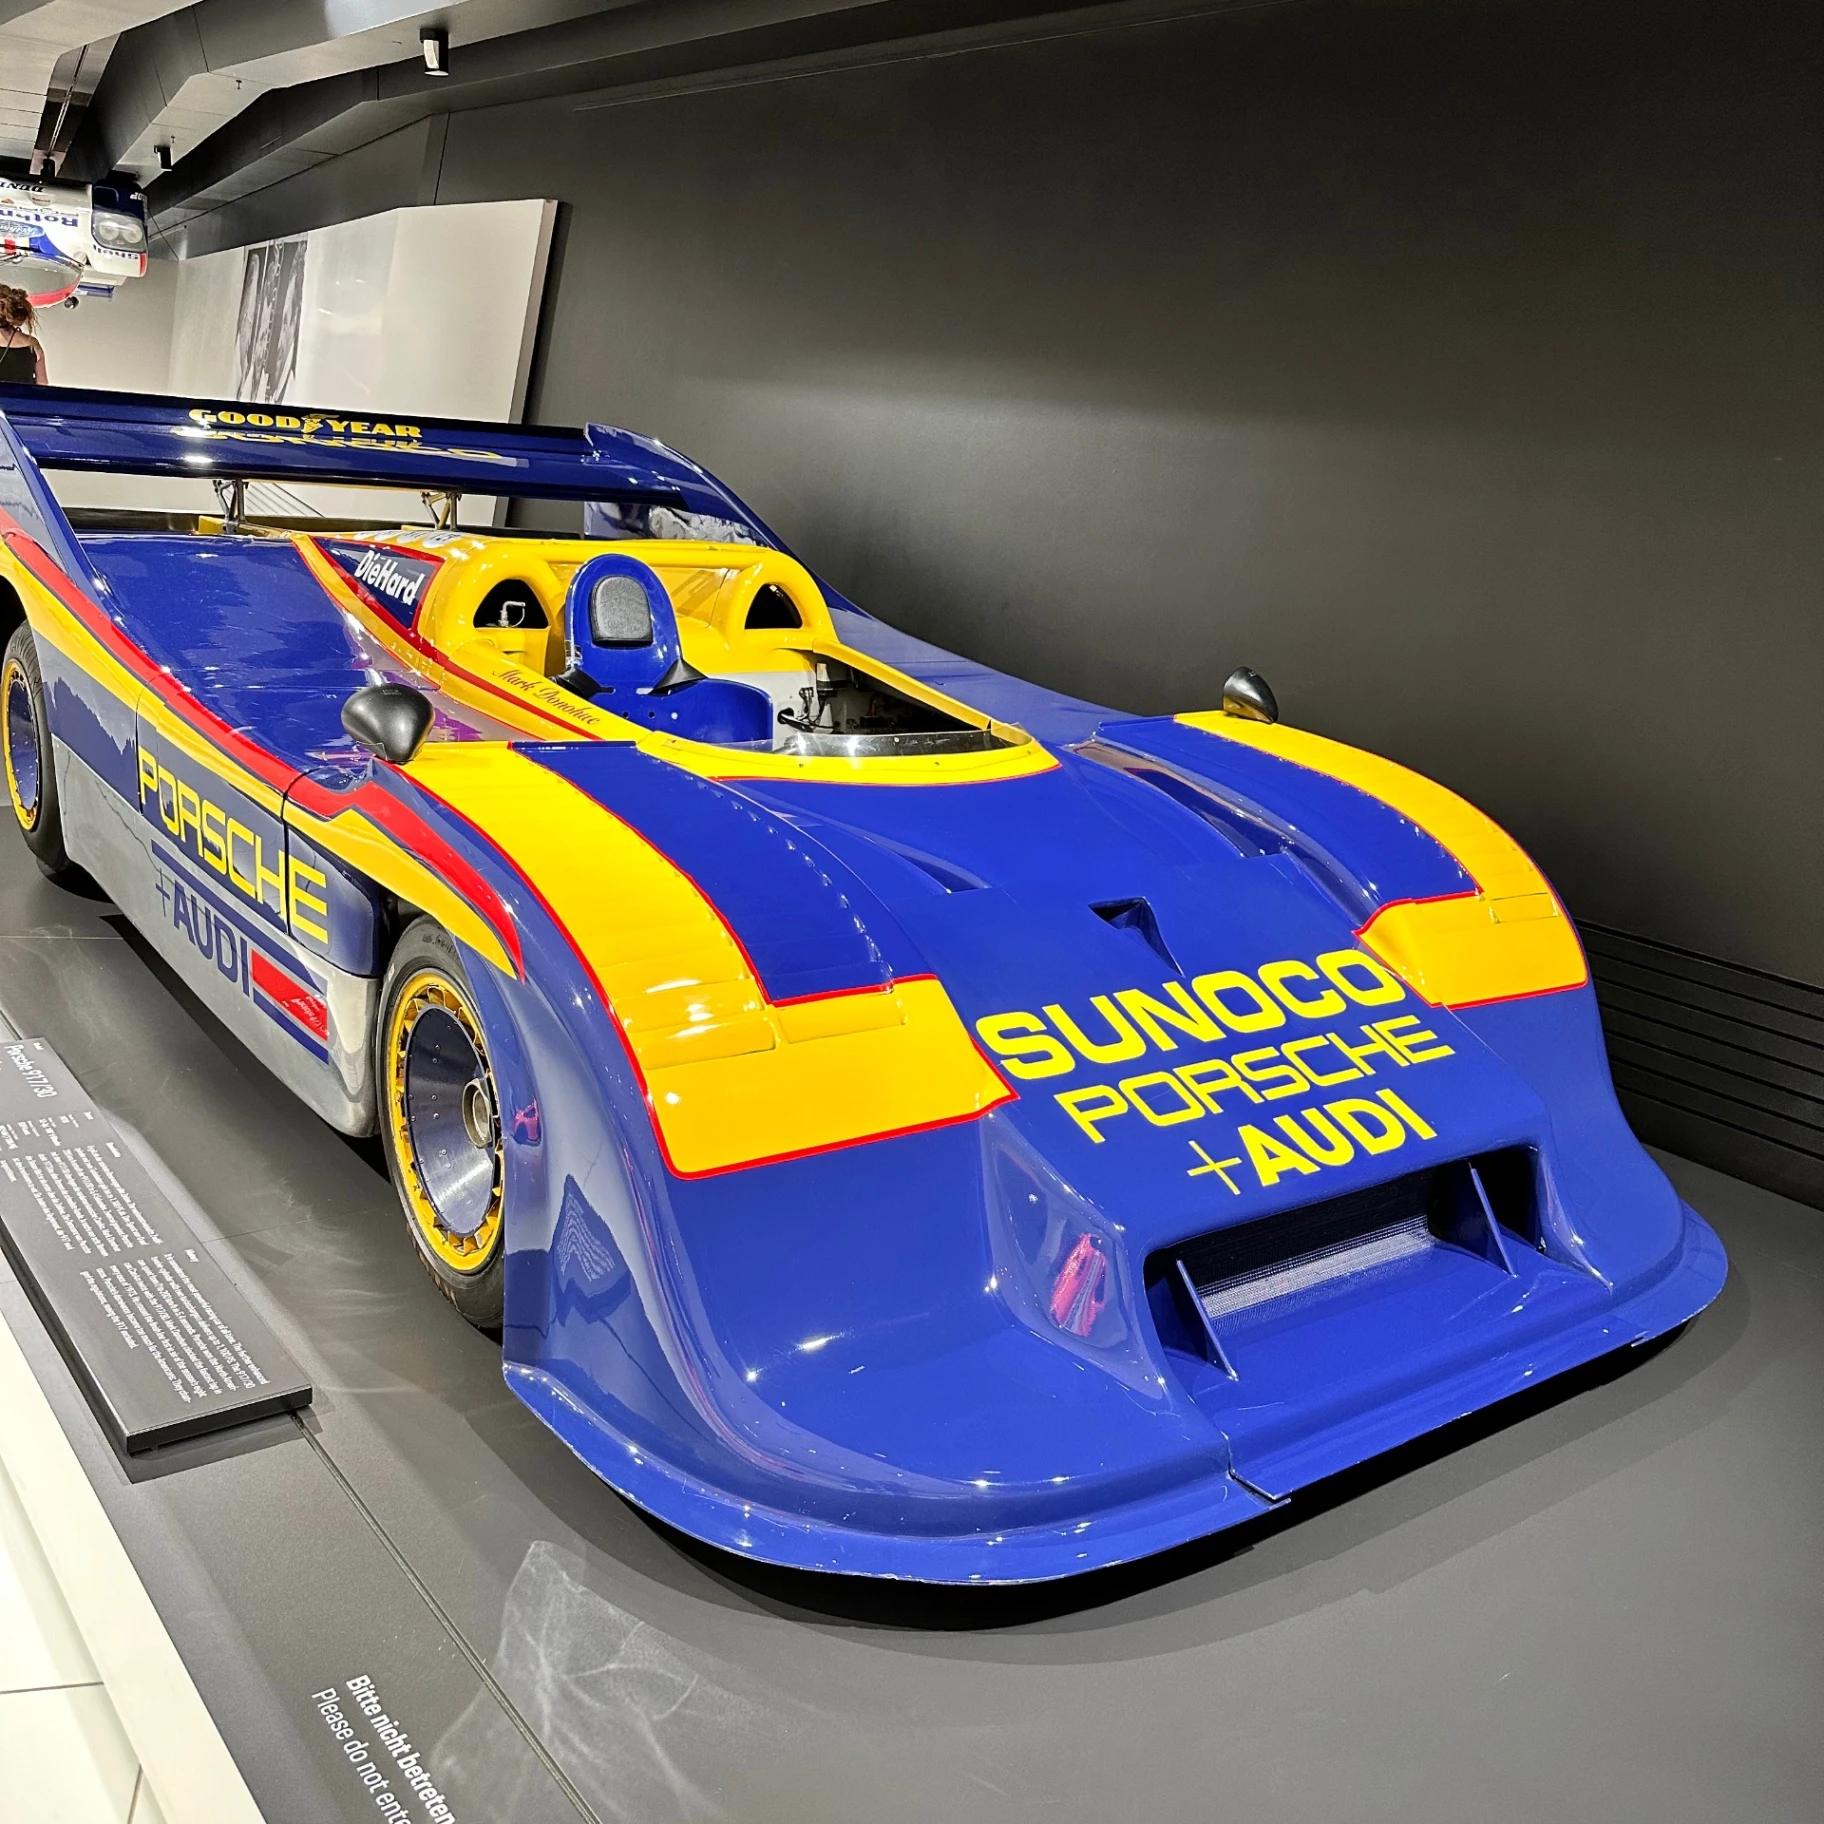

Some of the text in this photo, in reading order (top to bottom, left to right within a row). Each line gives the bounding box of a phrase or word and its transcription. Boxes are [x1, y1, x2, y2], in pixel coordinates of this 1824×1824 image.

[354, 549, 425, 606] DieHard
[492, 669, 601, 726] Mark Donohue
[138, 745, 329, 944] PORSCHE
[975, 948, 1407, 1080] SUNOCO
[4, 1044, 35, 1075] Porsche
[22, 1069, 58, 1098] 917/30
[1053, 1015, 1456, 1144] PORSCHE
[311, 1687, 354, 1740] Please
[343, 1739, 370, 1763] do
[346, 1674, 456, 1824] Bitte nicht betreten
[356, 1761, 390, 1794] not
